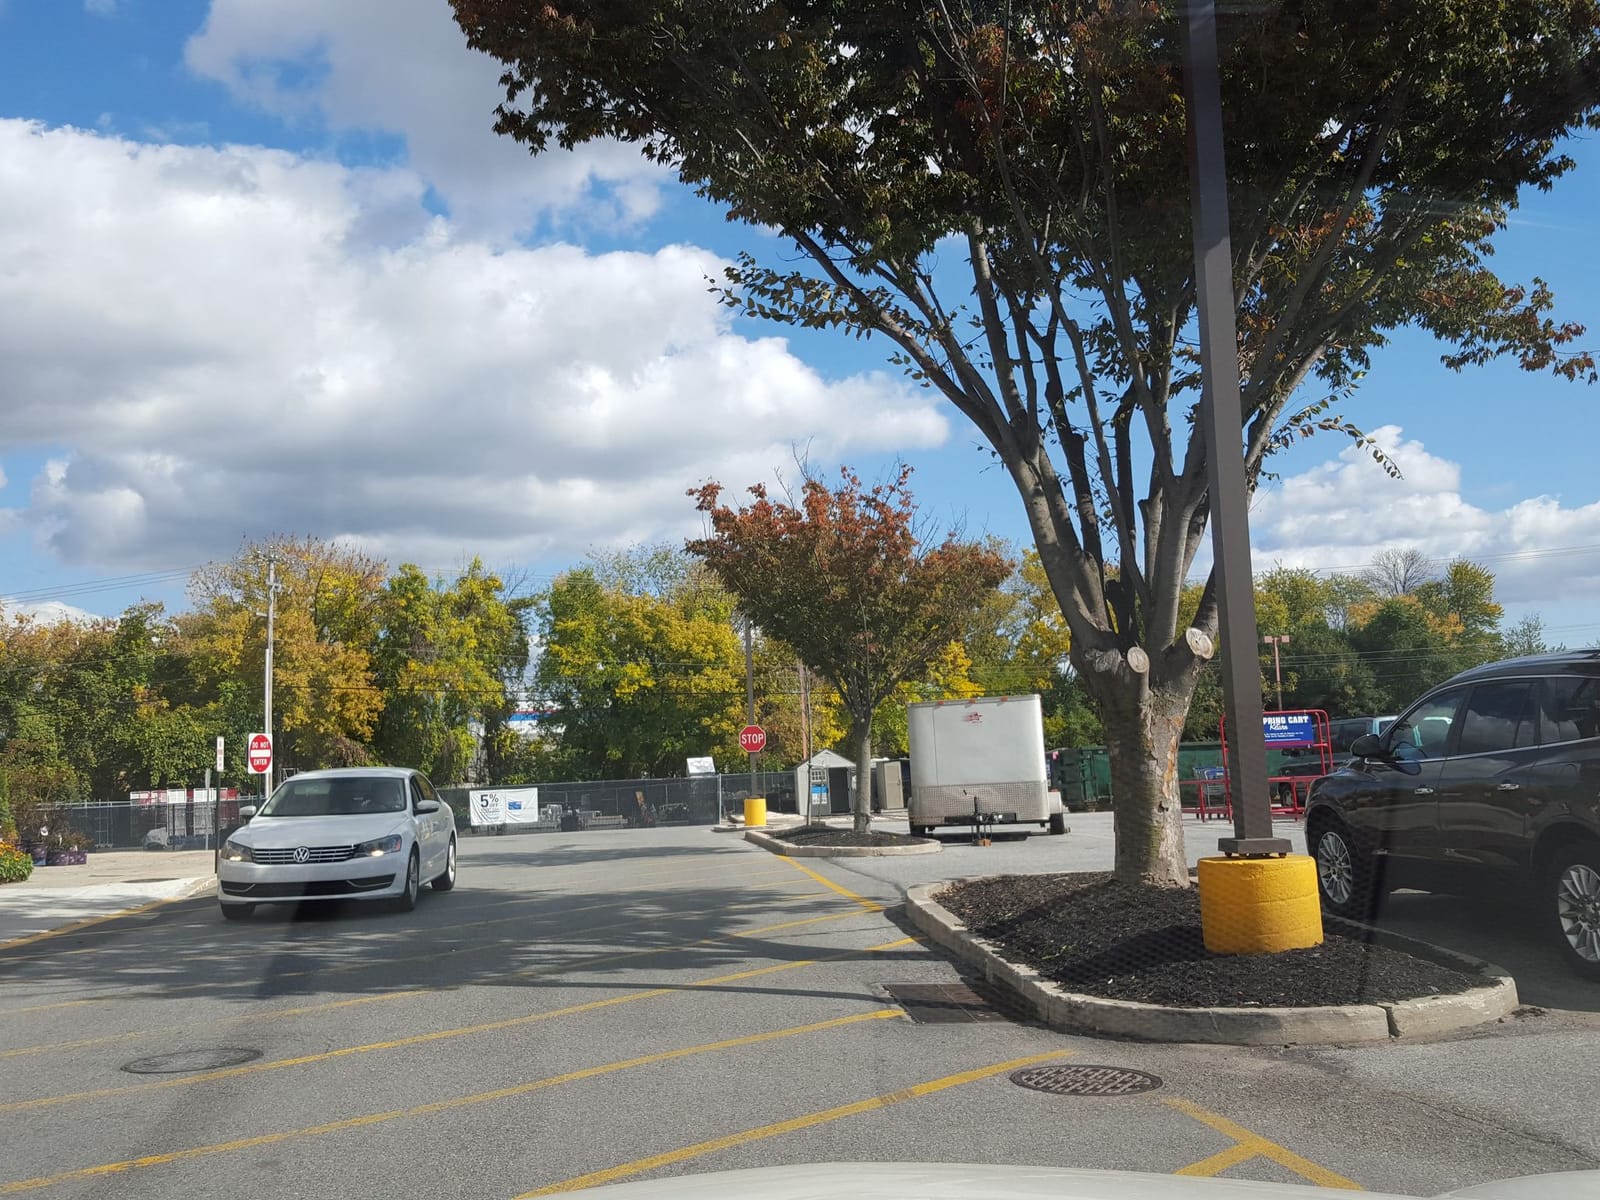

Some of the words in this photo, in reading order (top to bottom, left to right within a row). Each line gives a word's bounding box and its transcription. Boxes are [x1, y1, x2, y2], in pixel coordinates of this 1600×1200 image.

[1288, 715, 1308, 723] CART
[741, 734, 764, 744] STOP
[480, 793, 499, 808] 5%
